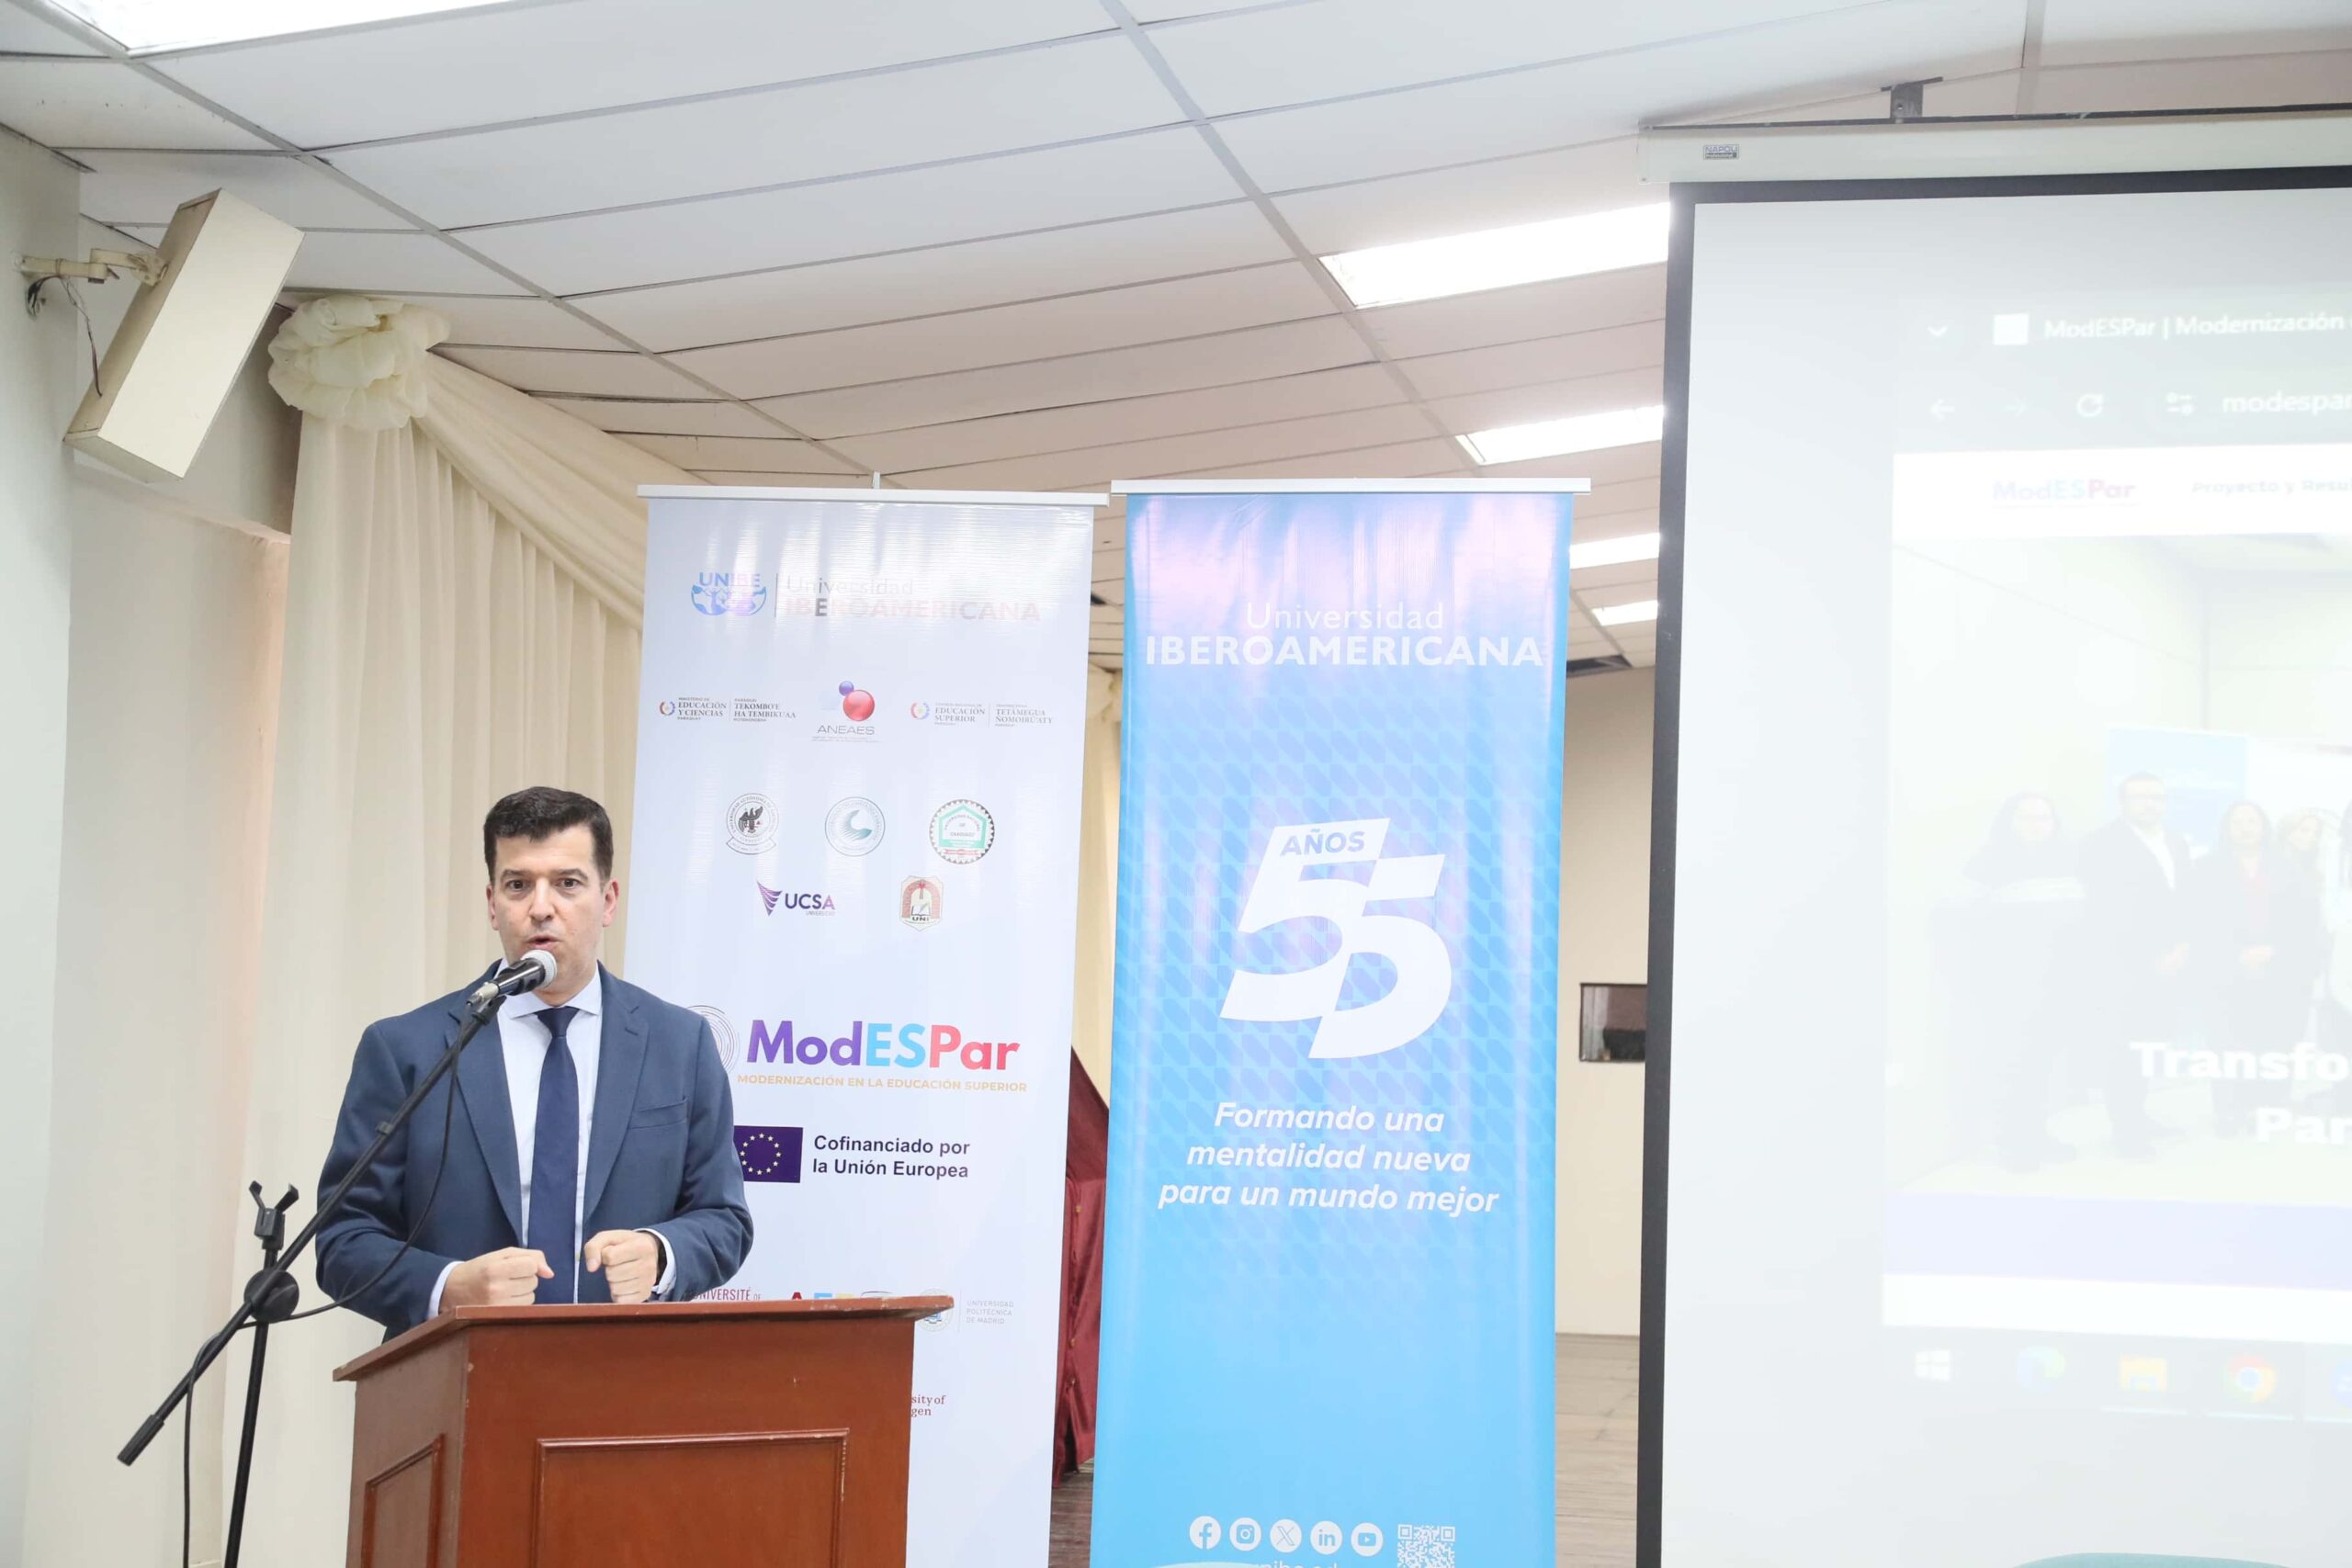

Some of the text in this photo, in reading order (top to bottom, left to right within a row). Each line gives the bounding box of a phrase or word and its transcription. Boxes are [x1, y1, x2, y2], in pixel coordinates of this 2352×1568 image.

[2044, 318, 2156, 339] ModESPar
[2176, 311, 2345, 336] Modernización
[1992, 479, 2137, 502] ModESPar
[1246, 602, 1443, 630] Universidad
[1146, 636, 1544, 667] IBEROAMERICANA
[678, 701, 727, 709] EDUCACIÓN
[934, 715, 976, 723] SUPERIOR
[817, 725, 876, 735] ANEAES
[1280, 829, 1365, 856] AÑOS
[785, 893, 835, 910] UCSA
[1219, 818, 1452, 1058] 55
[747, 1019, 1021, 1070] ModESPar
[737, 1074, 1027, 1092] MODERNIZACIÓN EN LA EDUCACIÓN SUPERIOR
[1215, 1101, 1444, 1133] Formando una
[814, 1135, 970, 1156] Cofinanciado por
[812, 1157, 968, 1179] la Unión Europea
[1187, 1143, 1471, 1172] mentalidad nueva
[1158, 1183, 1499, 1218] para un mundo mejor
[695, 1286, 751, 1301] NIVERSITÉ
[967, 1300, 1014, 1308] UNIVERSIDAD
[967, 1307, 1012, 1316] POLITÉCNICA
[911, 1394, 946, 1406] sity of
[911, 1408, 932, 1418] gen
